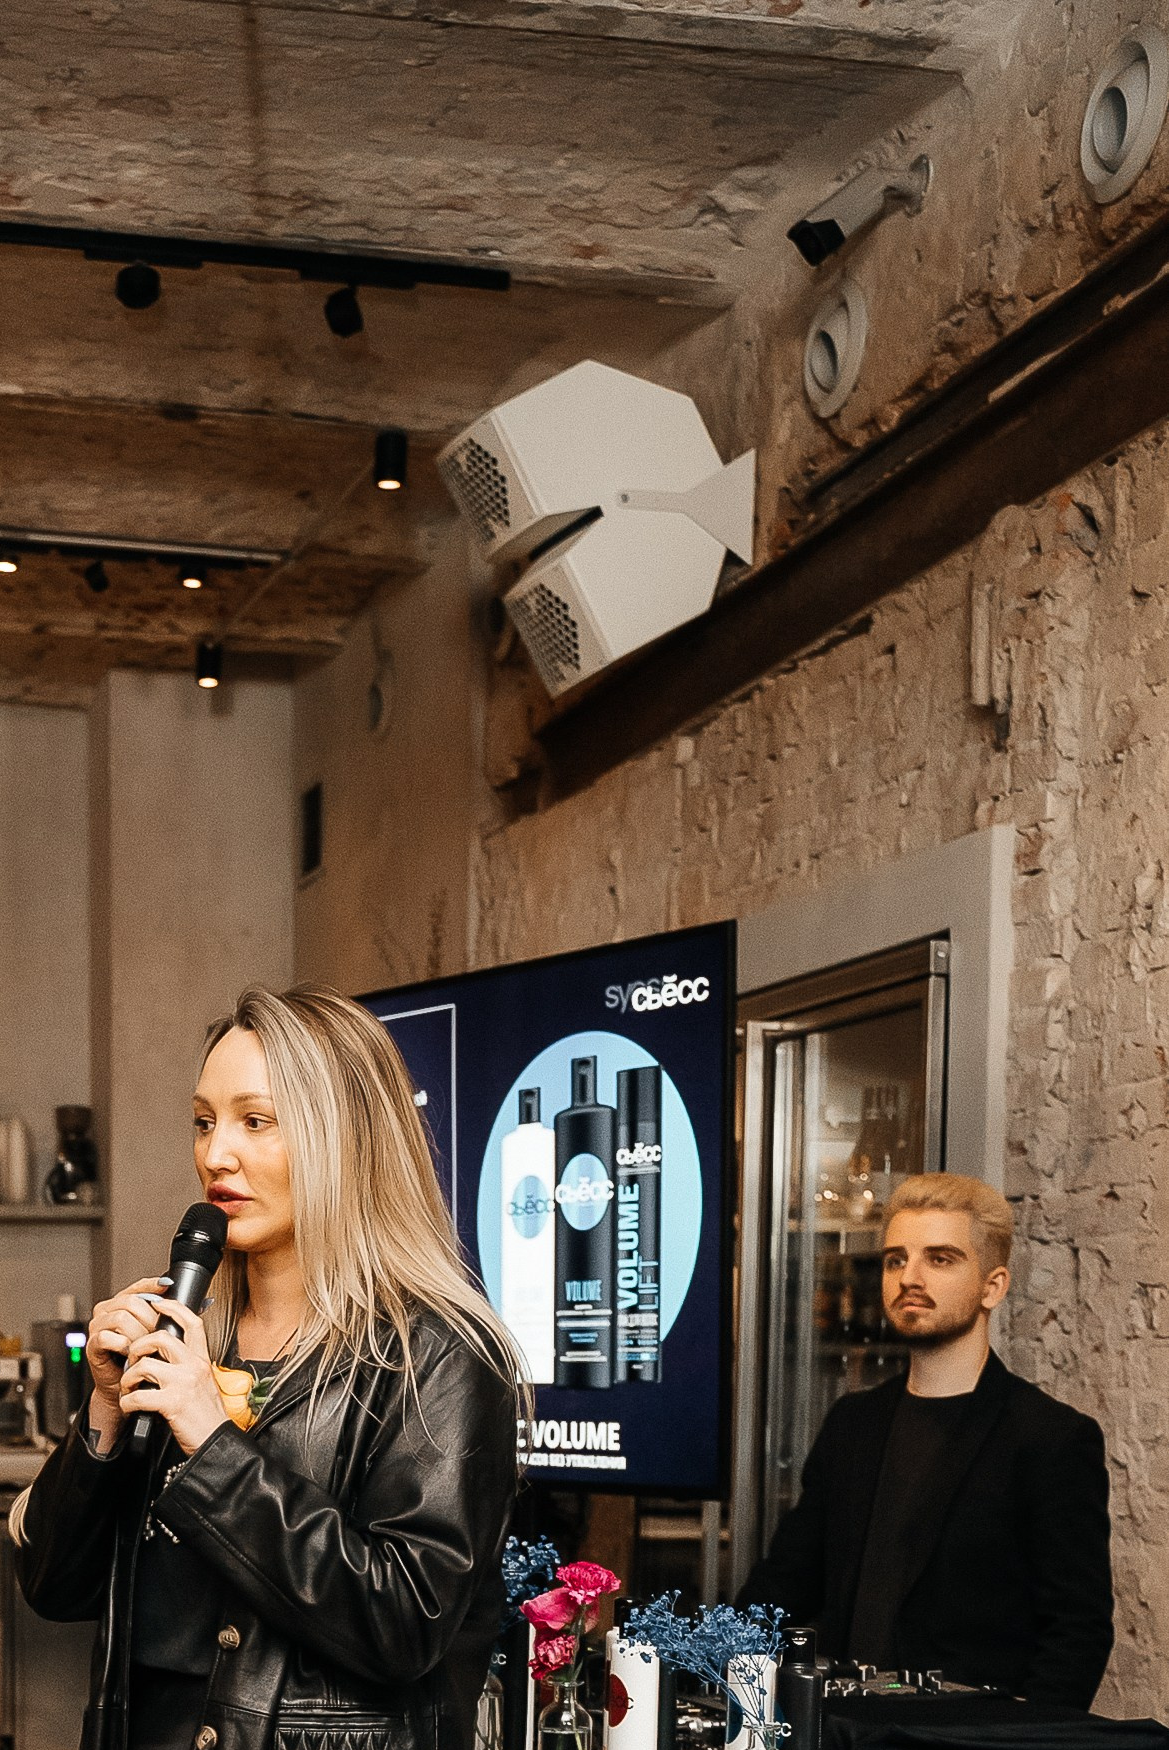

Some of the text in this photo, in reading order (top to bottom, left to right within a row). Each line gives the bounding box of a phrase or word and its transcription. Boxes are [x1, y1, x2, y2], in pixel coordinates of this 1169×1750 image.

[617, 1183, 640, 1310] VOLUME
[638, 1255, 659, 1310] LIFT
[532, 1419, 621, 1451] VOLUME
